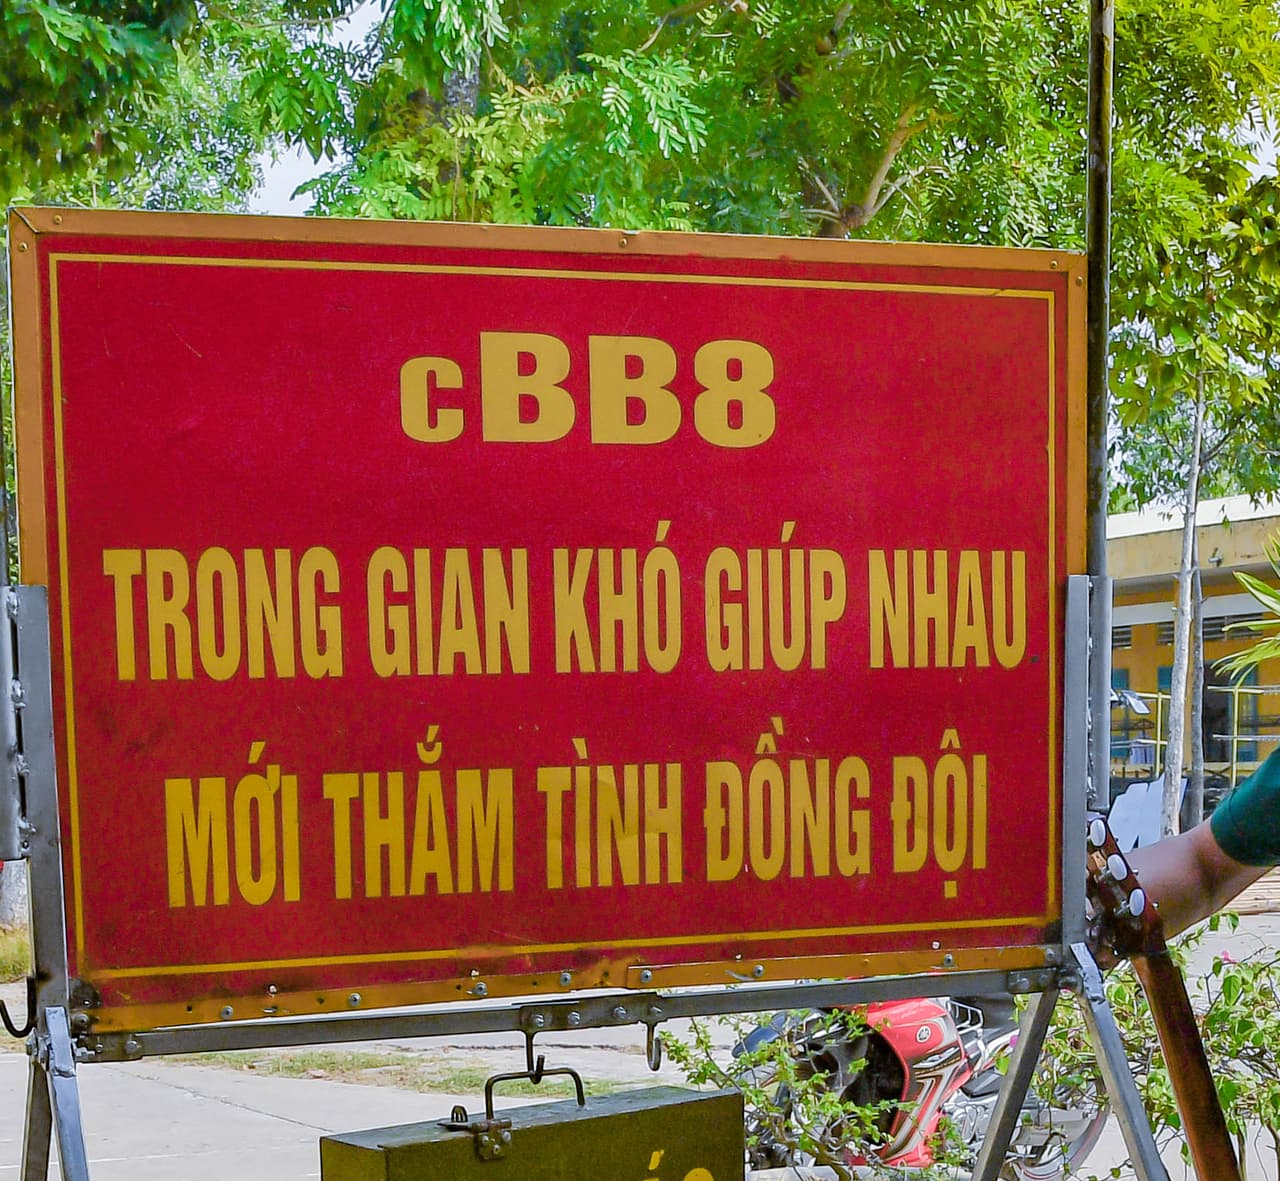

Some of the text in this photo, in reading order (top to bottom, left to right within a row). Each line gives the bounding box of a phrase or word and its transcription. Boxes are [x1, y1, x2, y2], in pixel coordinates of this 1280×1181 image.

[398, 331, 777, 449] cBB8
[103, 519, 1029, 682] TRONG GIAN KHÓ GIÚP NHAU
[163, 715, 988, 908] MỚI THẮM TÌNH ĐỒNG ĐỘI
